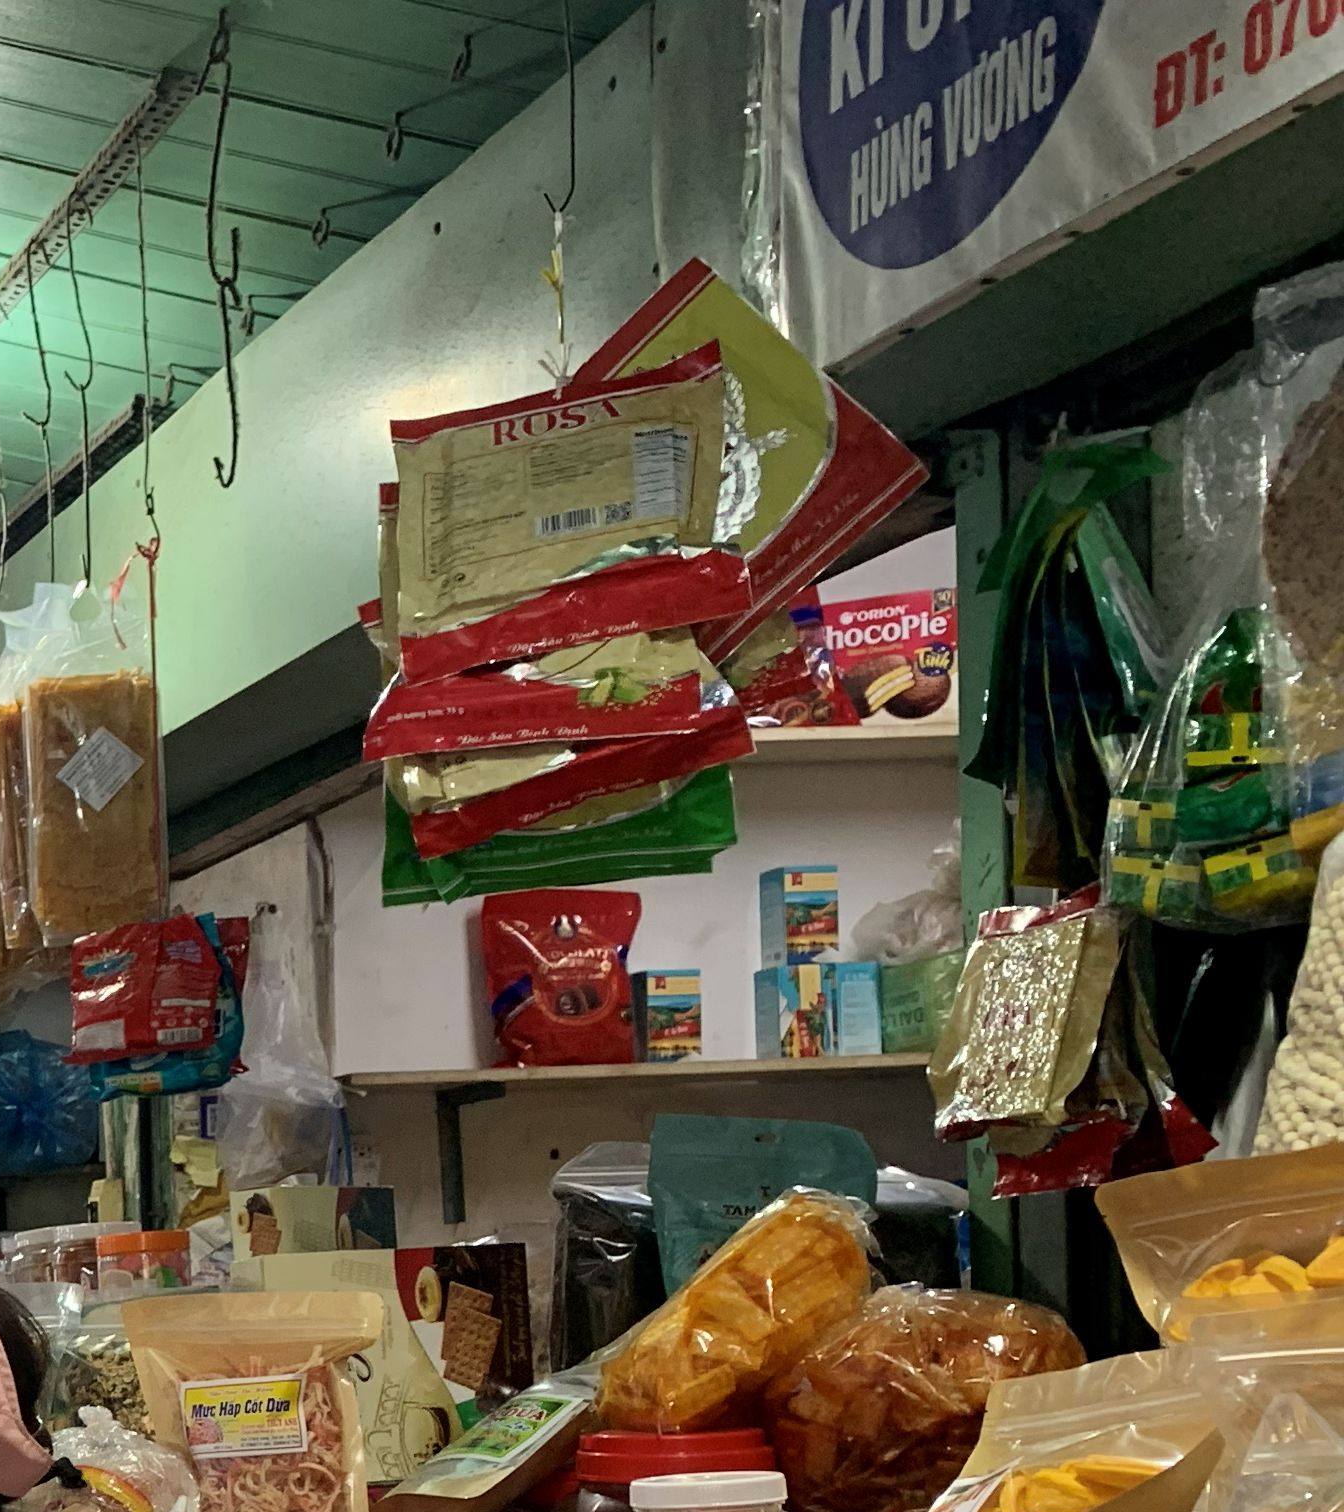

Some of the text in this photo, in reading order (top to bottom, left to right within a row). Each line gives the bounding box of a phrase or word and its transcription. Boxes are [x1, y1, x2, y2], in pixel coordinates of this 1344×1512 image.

[1154, 0, 1344, 129] ĐT: 070
[850, 16, 1057, 234] HÙNG VƯƠNG
[493, 400, 621, 446] ROSA
[824, 611, 948, 650] hocoPie
[857, 605, 906, 621] ORION
